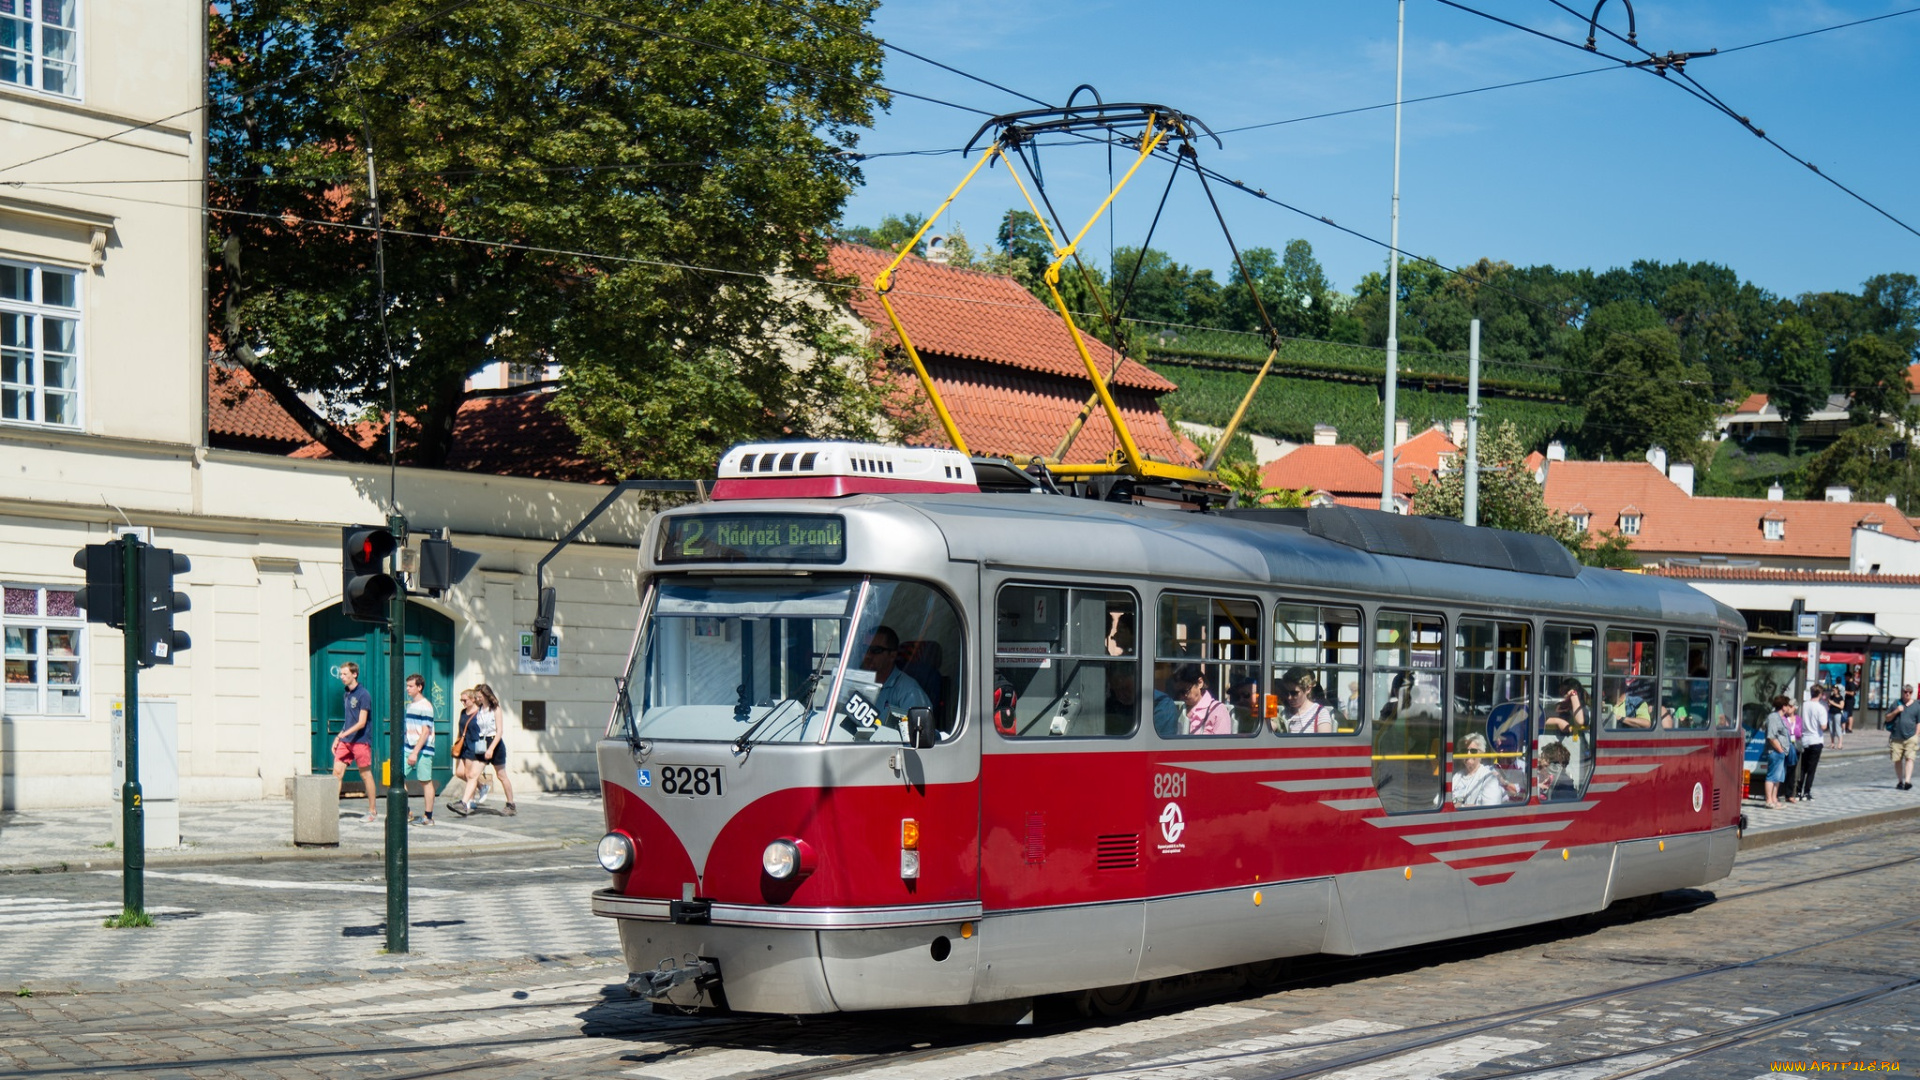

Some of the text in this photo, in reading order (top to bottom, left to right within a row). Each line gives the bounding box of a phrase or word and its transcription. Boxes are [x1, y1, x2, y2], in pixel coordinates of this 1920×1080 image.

[683, 519, 842, 555] 2 Nádraží Braník
[846, 694, 878, 728] 505
[661, 766, 723, 796] 8281
[1154, 772, 1187, 799] 8281
[133, 794, 141, 806] 2
